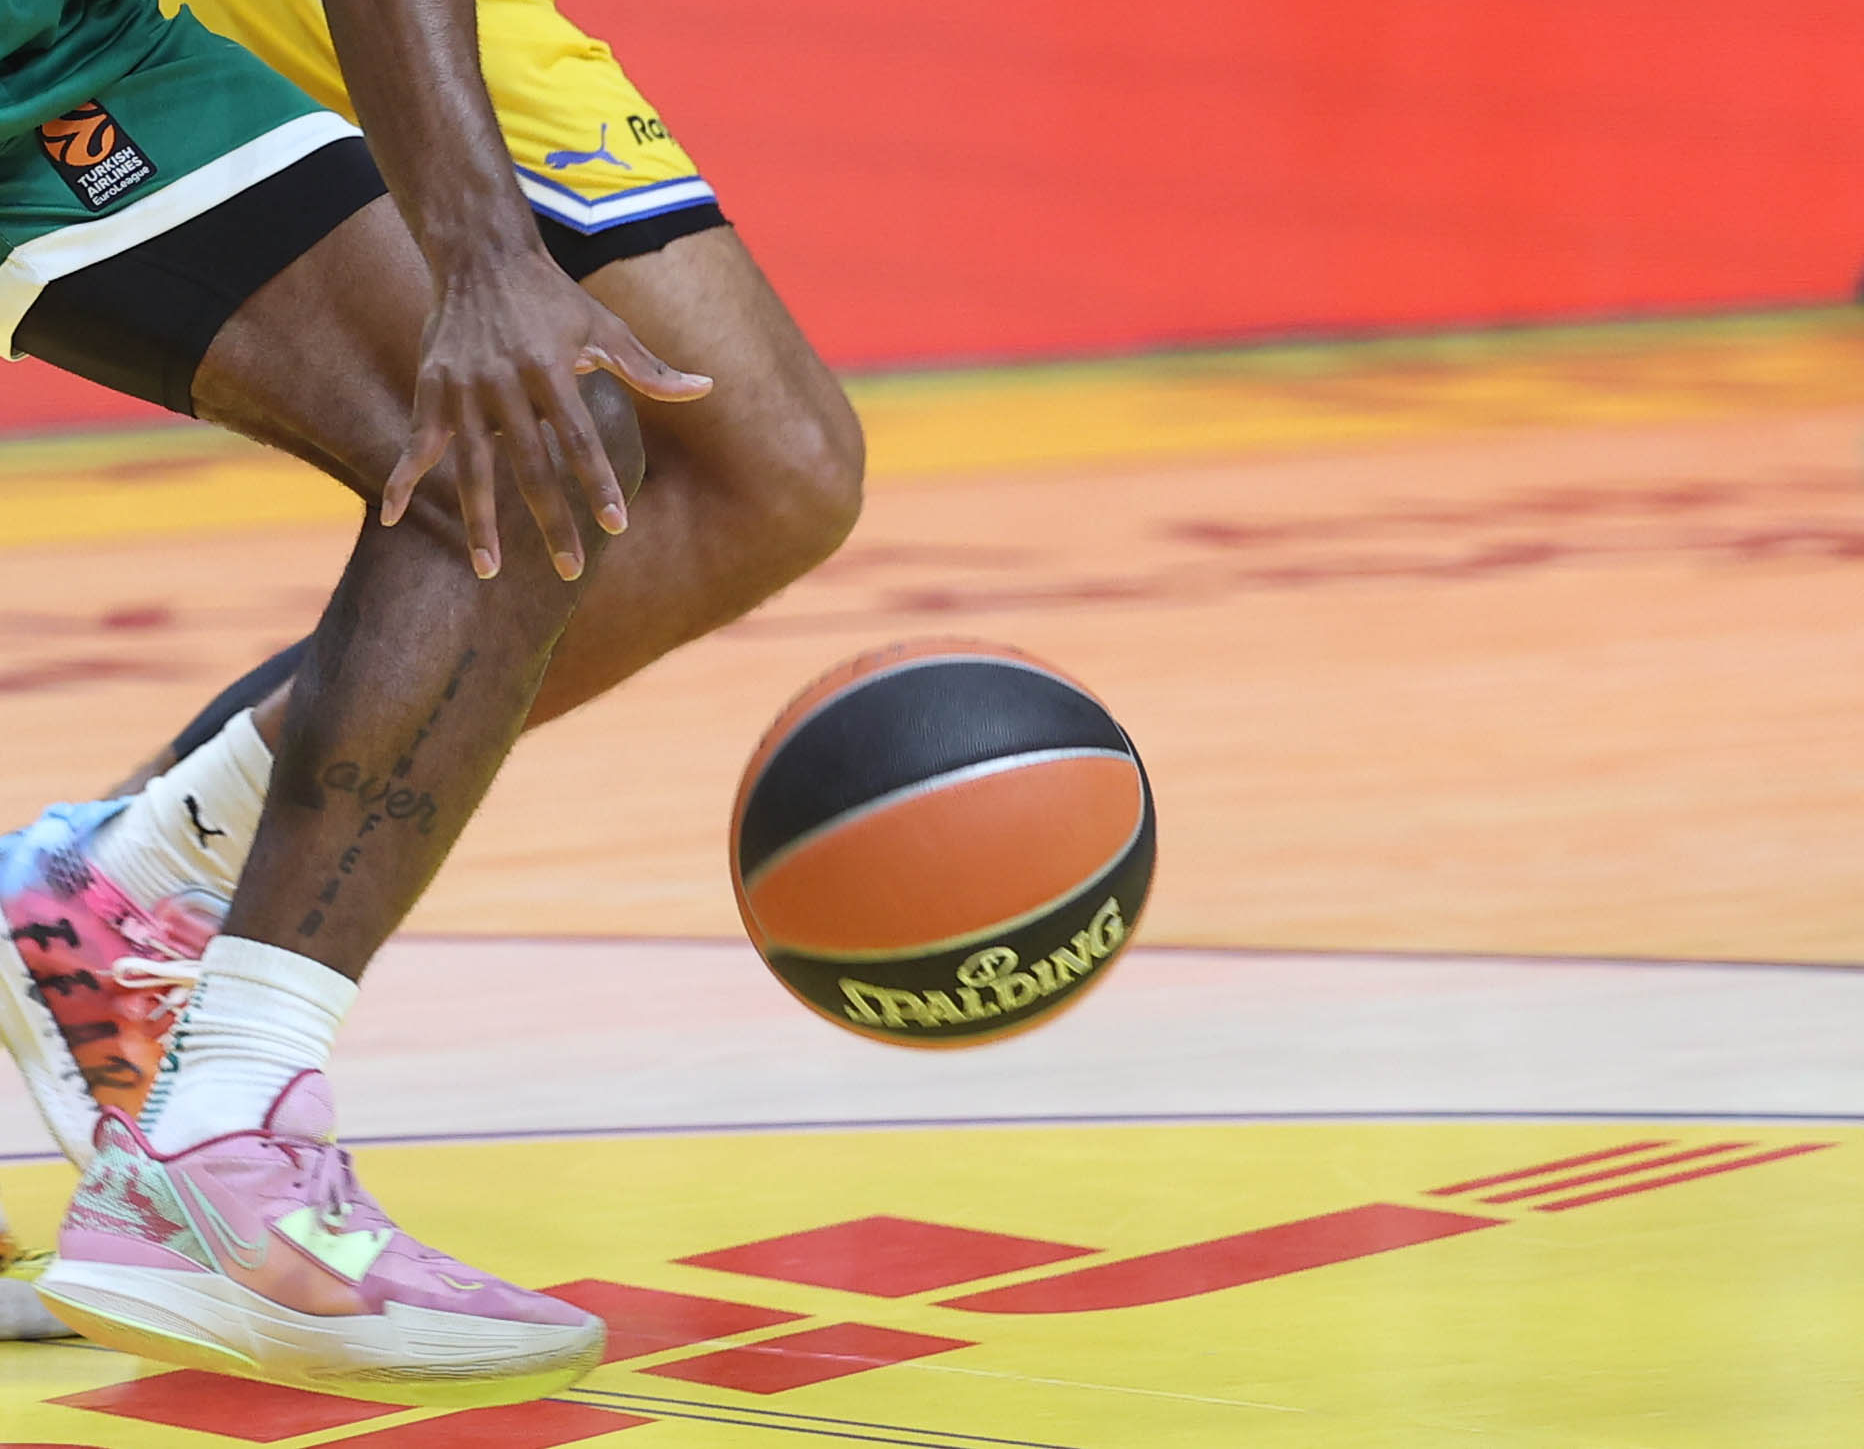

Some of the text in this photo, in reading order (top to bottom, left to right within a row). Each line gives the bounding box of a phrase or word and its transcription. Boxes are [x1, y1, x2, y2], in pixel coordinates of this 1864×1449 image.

[77, 146, 135, 188] TURKISH
[86, 156, 143, 198] AIRLINES
[838, 896, 1129, 1028] SPALDING
